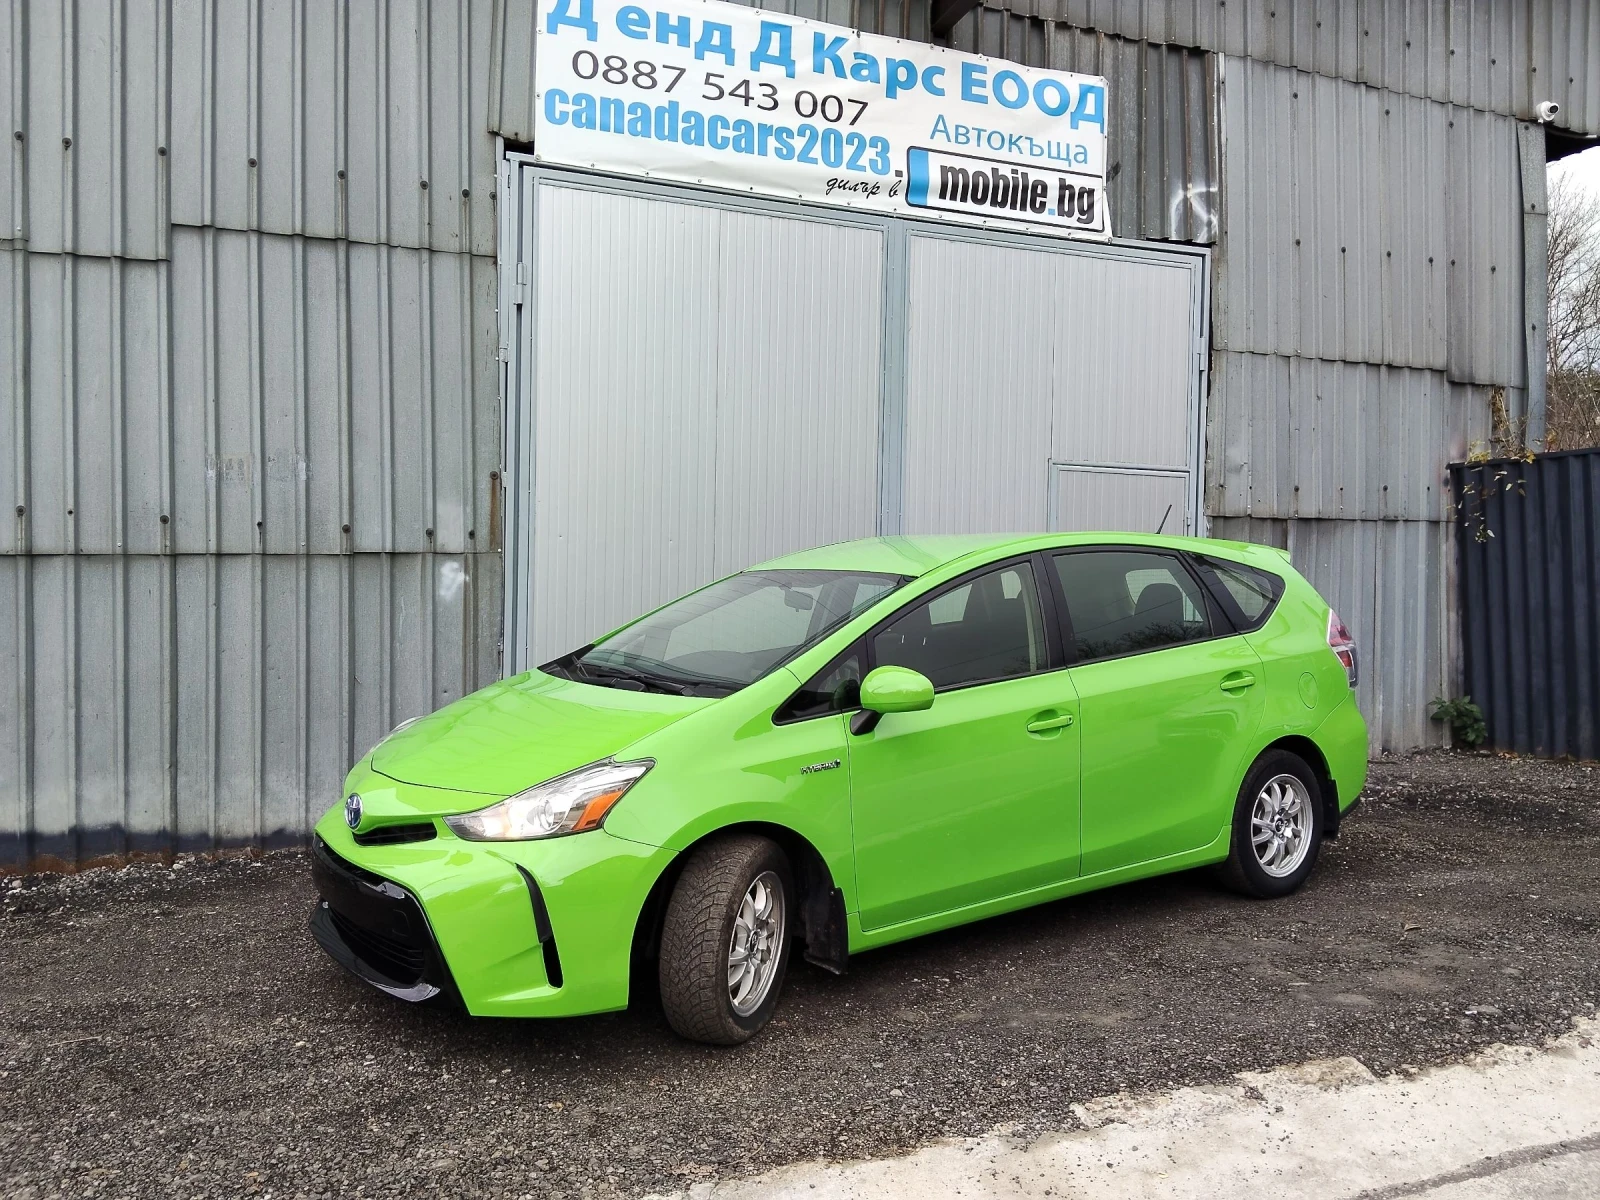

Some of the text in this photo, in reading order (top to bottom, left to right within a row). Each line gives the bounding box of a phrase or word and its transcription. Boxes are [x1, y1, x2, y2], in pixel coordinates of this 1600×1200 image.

[546, 0, 1105, 134] Д енд Д Карс ЕООД
[572, 50, 868, 126] 0887 543 007
[930, 114, 1089, 167] Автокъща
[939, 165, 1095, 224] mobile.bg
